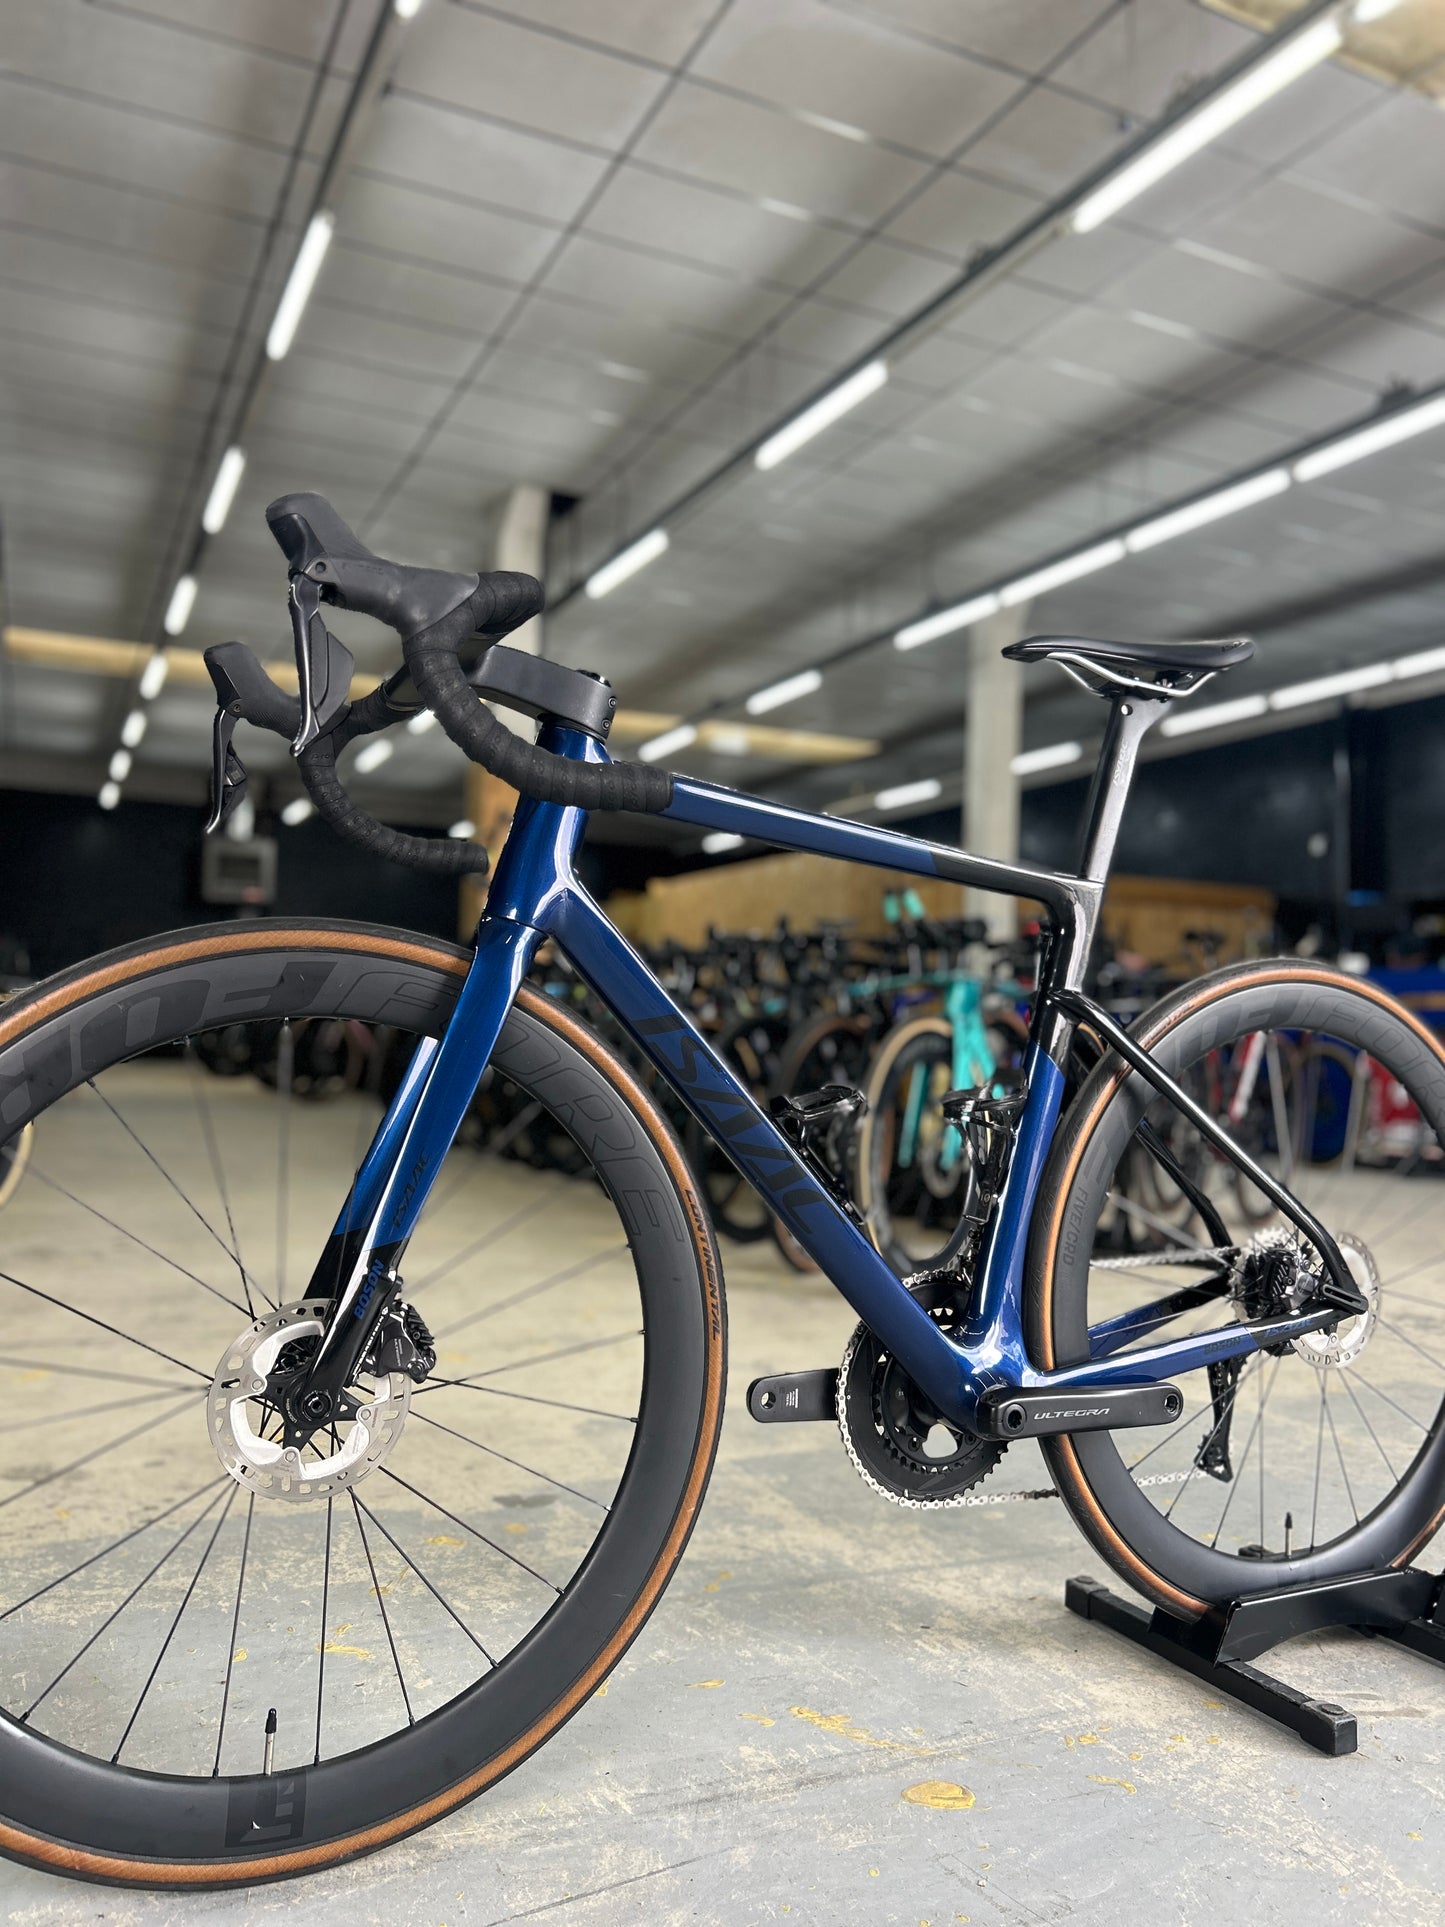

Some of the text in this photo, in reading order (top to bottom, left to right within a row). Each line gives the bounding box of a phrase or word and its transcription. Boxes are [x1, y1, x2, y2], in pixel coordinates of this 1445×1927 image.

[633, 1016, 846, 1236] ISAAC
[392, 1151, 430, 1228] ISAAC
[1063, 1187, 1089, 1266] FIVE/CRD
[353, 1258, 385, 1320] BOSON
[686, 1190, 721, 1341] CONTINENTAL
[1034, 1407, 1110, 1420] ULTEGRA
